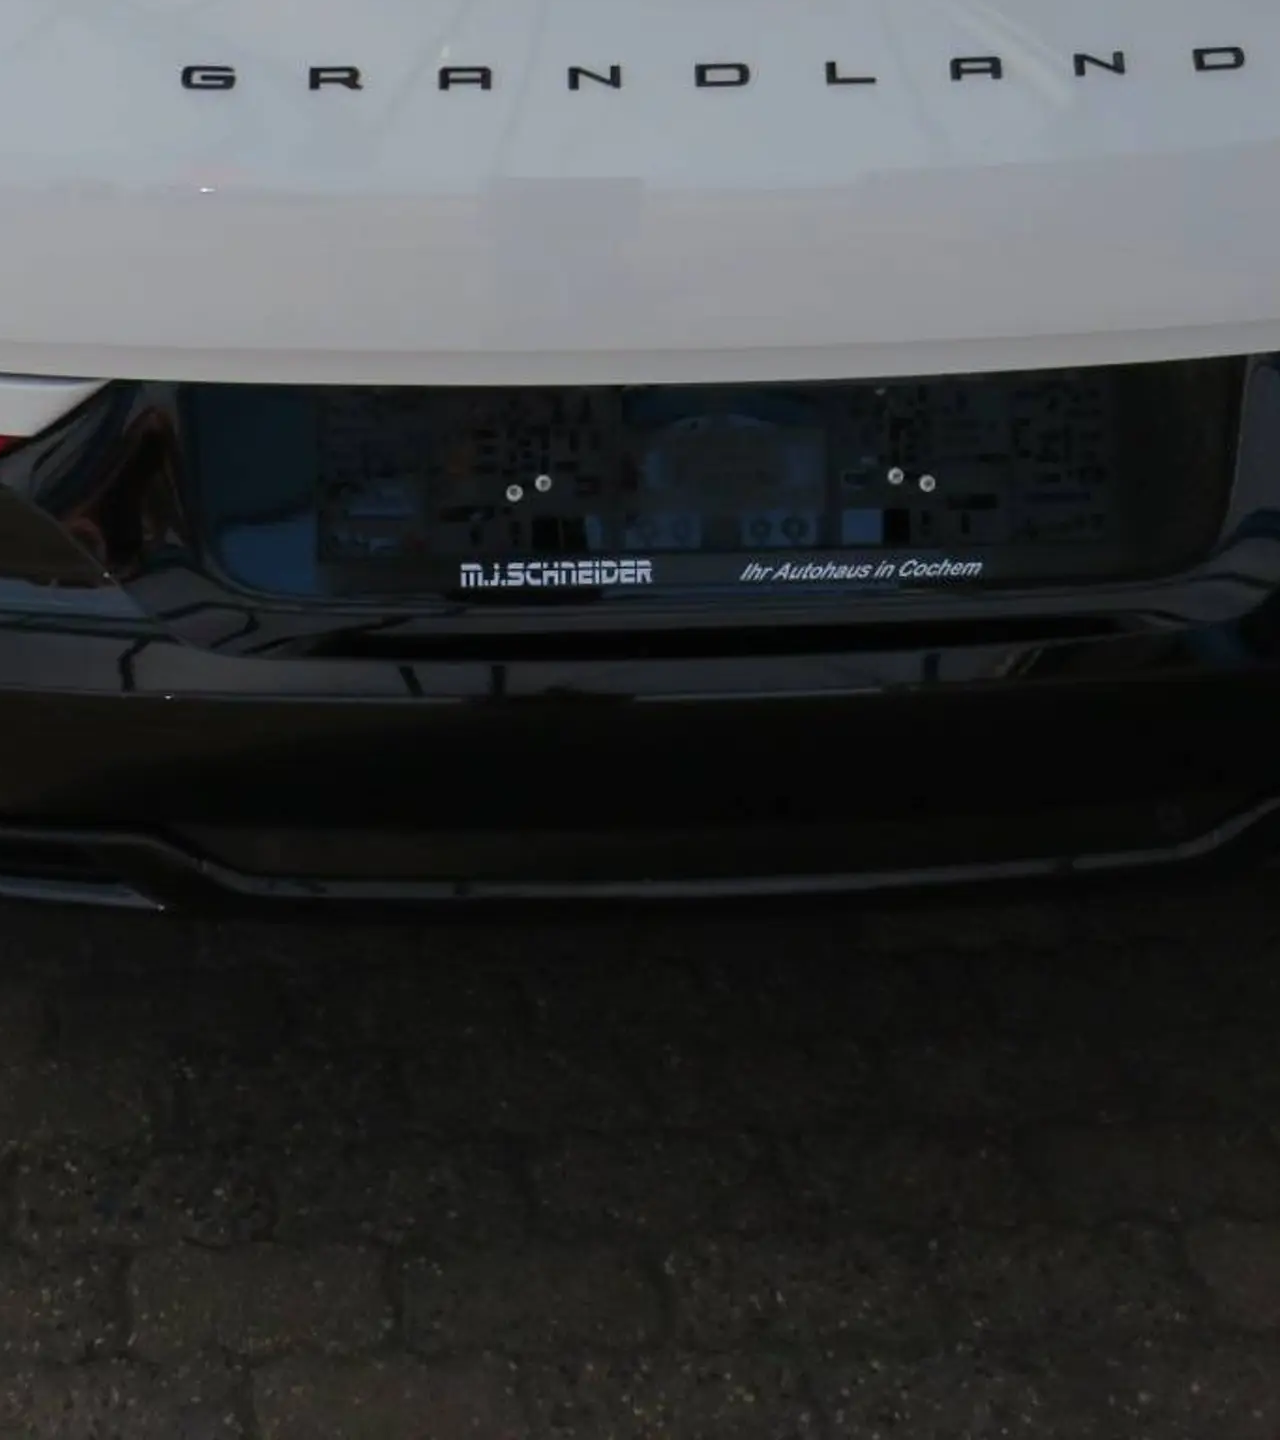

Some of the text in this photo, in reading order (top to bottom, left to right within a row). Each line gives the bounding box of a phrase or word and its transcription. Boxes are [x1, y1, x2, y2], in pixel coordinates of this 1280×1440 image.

[180, 45, 1245, 91] GRANDLAND
[739, 559, 984, 582] Ihr Autohaus in Cochem
